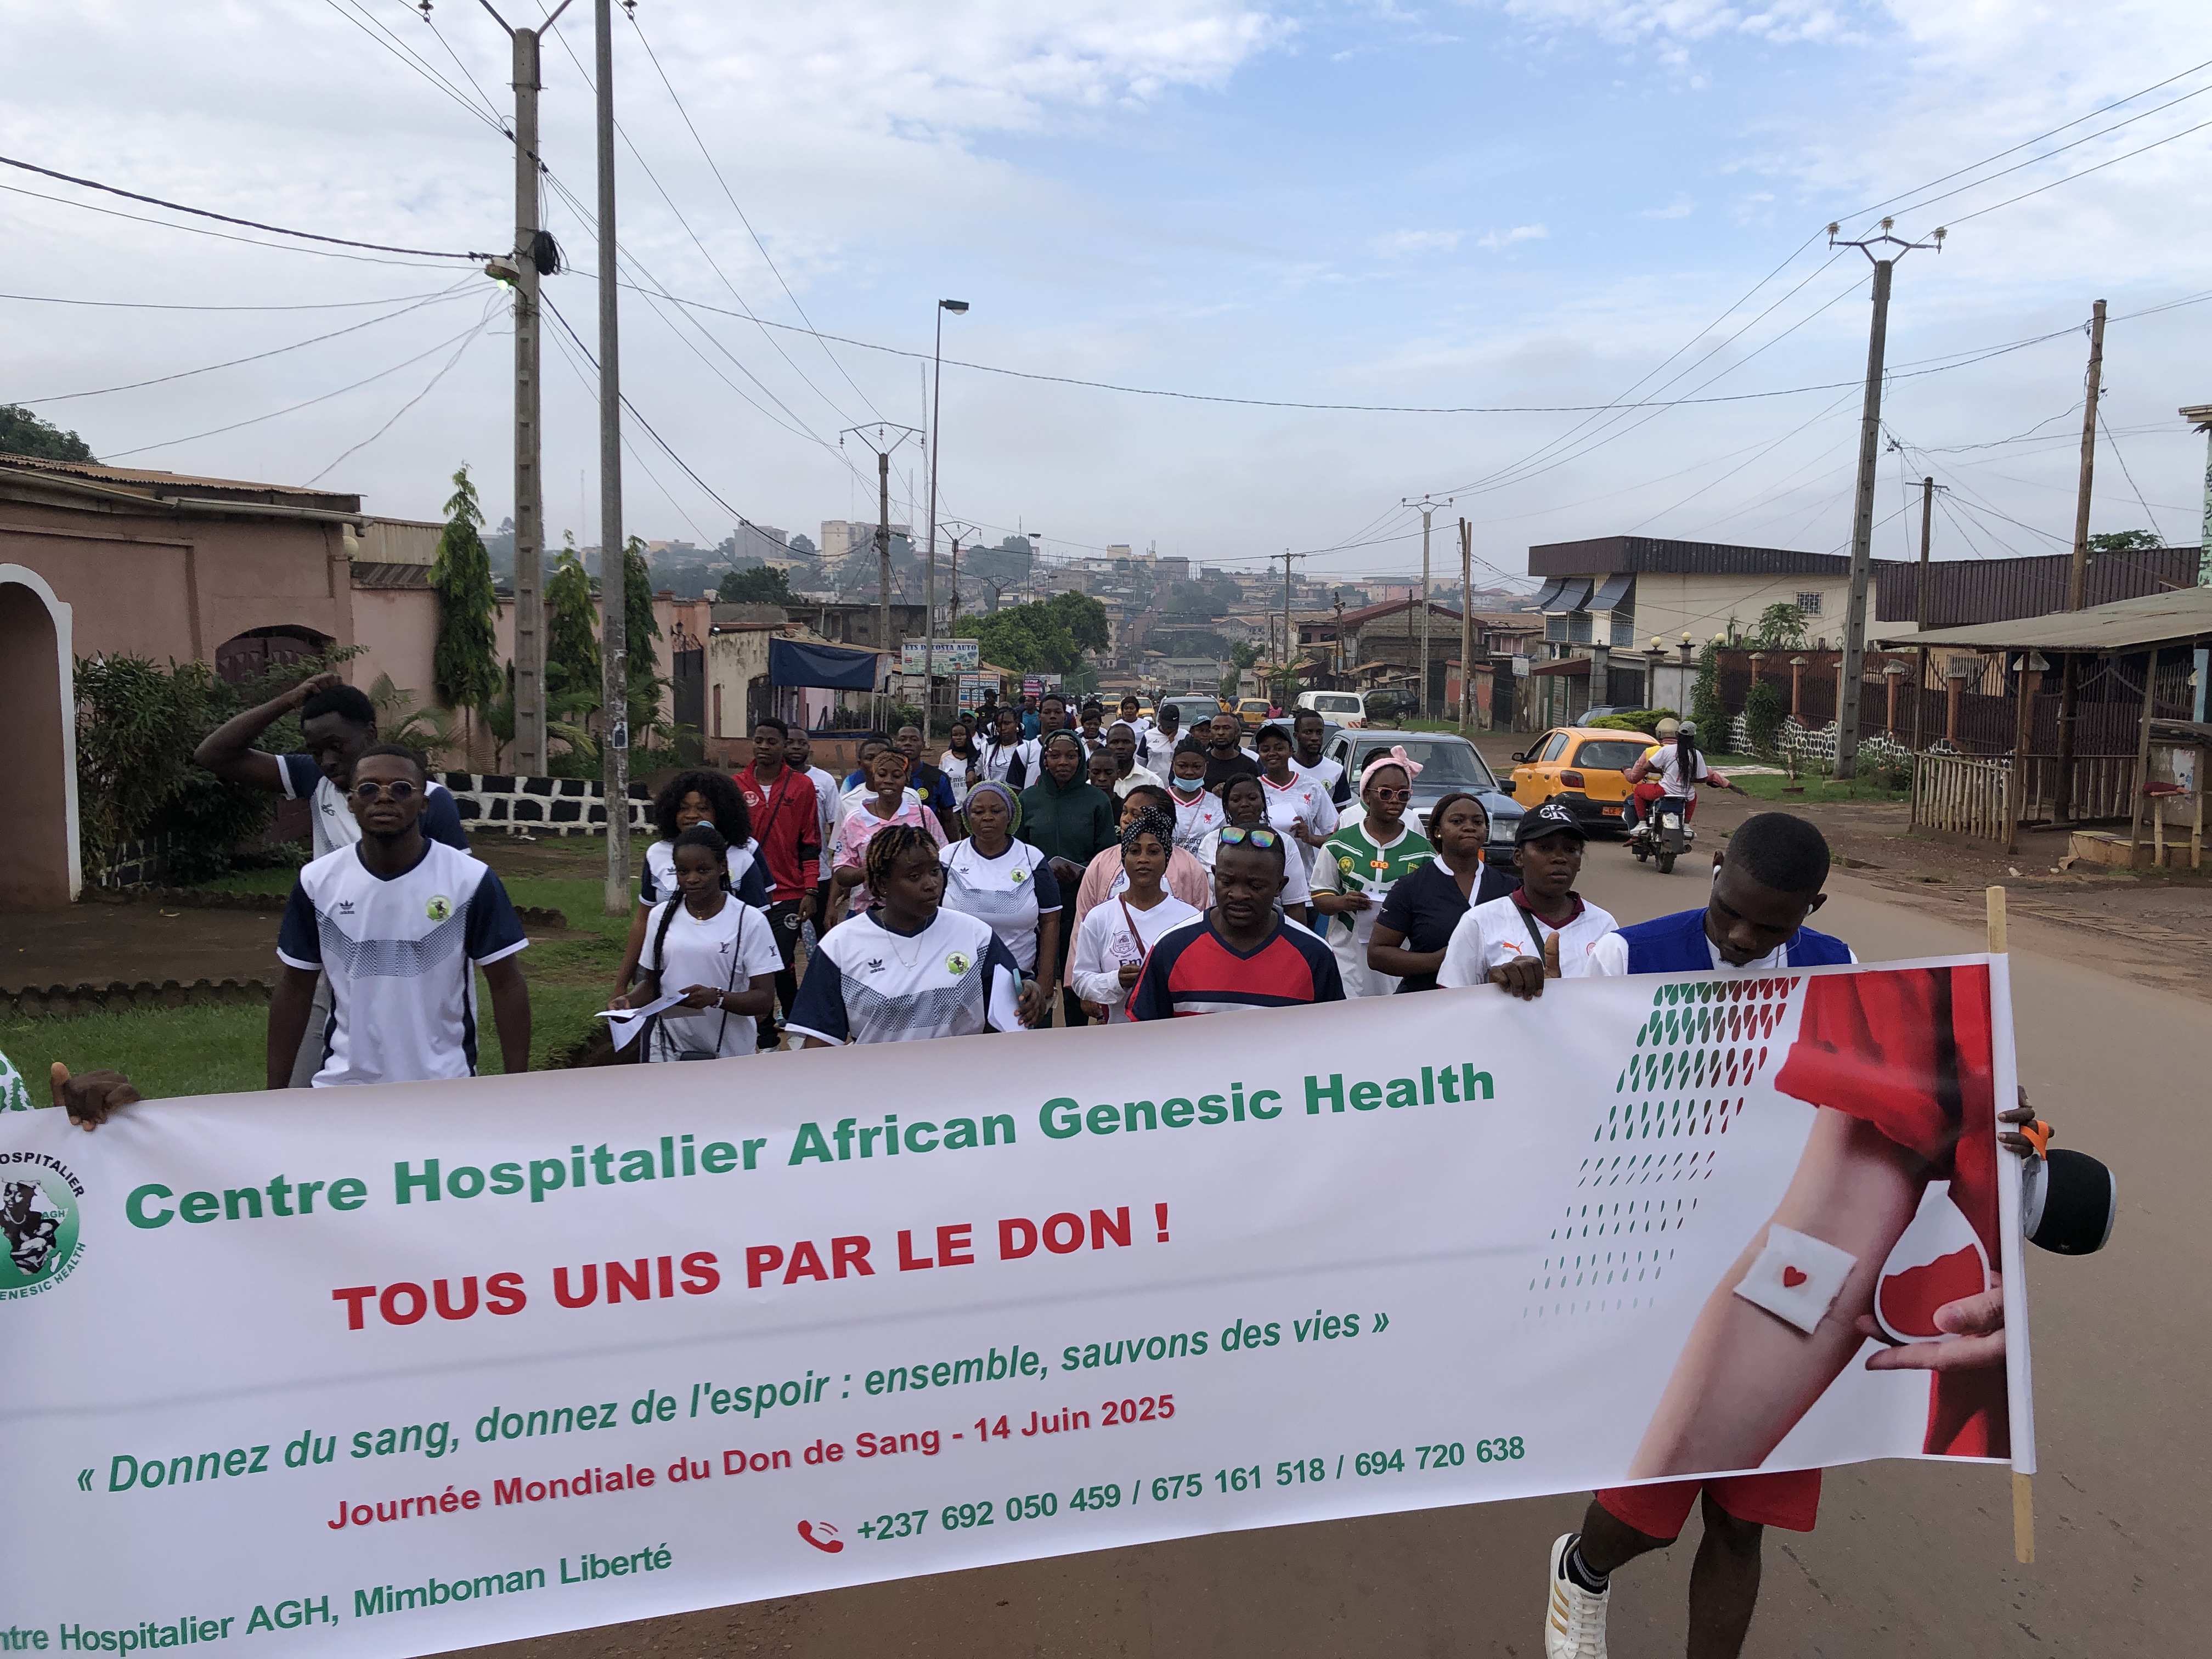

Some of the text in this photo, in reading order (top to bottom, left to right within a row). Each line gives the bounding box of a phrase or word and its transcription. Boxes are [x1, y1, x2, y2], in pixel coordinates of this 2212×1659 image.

[1370, 860, 1389, 869] one
[127, 1063, 1494, 1229] Centre Hospitalier African Genesic Health
[42, 1210, 65, 1219] AGH
[54, 1242, 86, 1284] HEALTH
[332, 1203, 1169, 1330] TOUS UNIS PAR LE DON !
[109, 1445, 269, 1492] Donnez
[285, 1430, 336, 1468] du
[351, 1422, 460, 1458] sang,
[476, 1403, 617, 1443] donnez
[631, 1389, 676, 1425] de
[690, 1370, 830, 1419] l'espoir
[865, 1345, 1048, 1395] ensemble,
[1062, 1330, 1208, 1370] sauvons
[1221, 1318, 1280, 1352] des
[1294, 1310, 1359, 1342] vies
[328, 1485, 481, 1530] Journée
[494, 1464, 655, 1505] Mondiale
[668, 1457, 710, 1483] du
[724, 1450, 791, 1476] Don
[804, 1439, 844, 1465] de
[856, 1430, 940, 1458] Sang
[974, 1415, 1010, 1442] 14
[1022, 1407, 1090, 1436] Juin
[1102, 1395, 1175, 1426] 2025
[857, 1436, 1525, 1541] +237 692 050 459 / 675 161 518 / 694 720 638
[0, 1543, 672, 1657] ntre Hospitalier AGH, Mimboman Liberté
